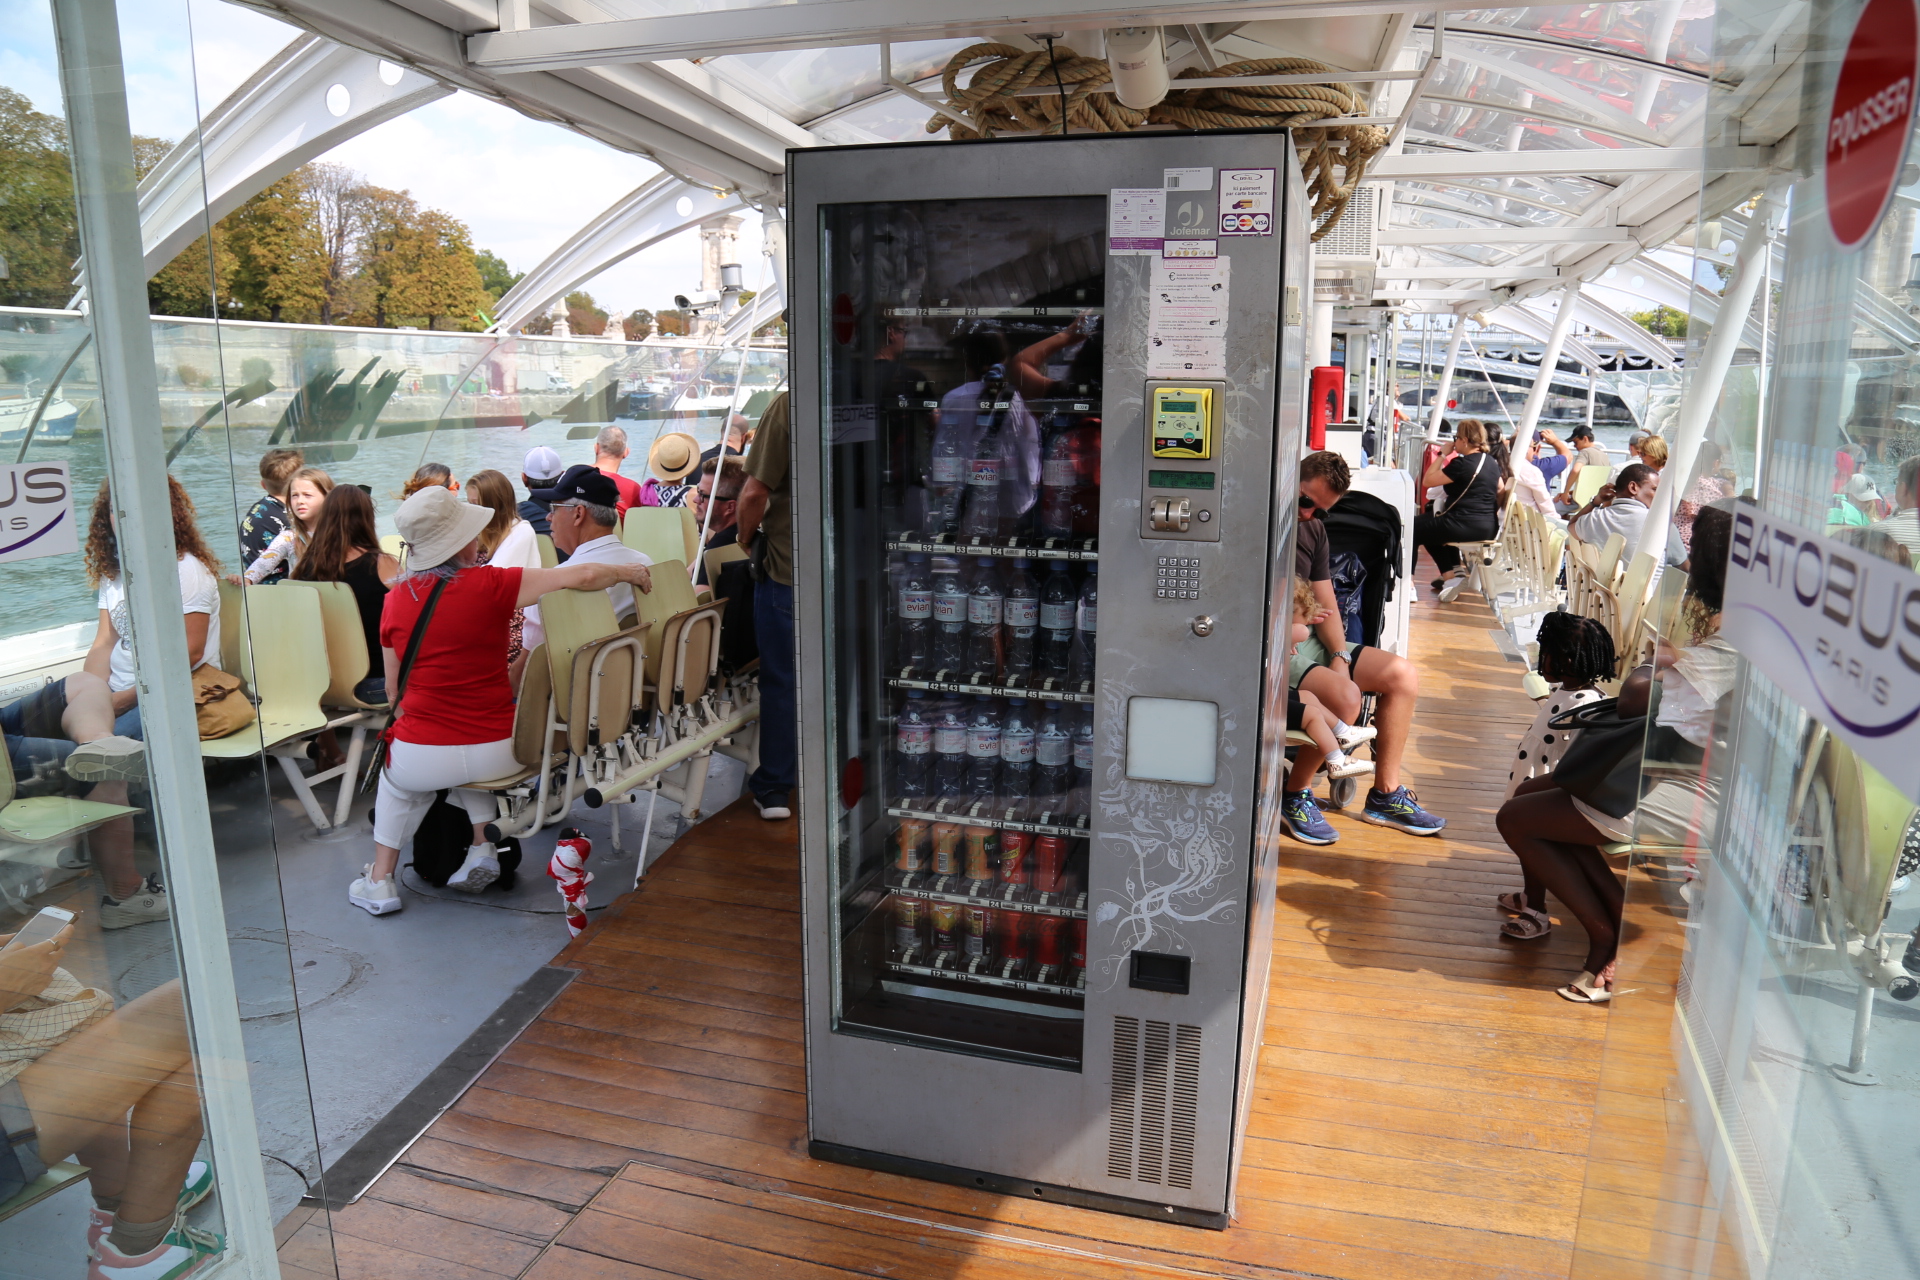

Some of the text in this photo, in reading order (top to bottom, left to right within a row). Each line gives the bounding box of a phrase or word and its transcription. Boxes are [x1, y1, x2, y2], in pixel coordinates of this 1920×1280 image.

[1829, 77, 1911, 162] POUSSER
[1170, 226, 1211, 236] Jofemar
[975, 472, 997, 481] evian
[1027, 549, 1037, 557] 55
[1069, 551, 1079, 559] 56
[1731, 512, 1920, 675] BATOBUS
[907, 603, 930, 611] evian
[1815, 637, 1892, 706] PARIS
[11, 682, 38, 694] JACKETS
[889, 679, 897, 687] 41
[992, 688, 1002, 696] 44
[1024, 824, 1034, 832] 35
